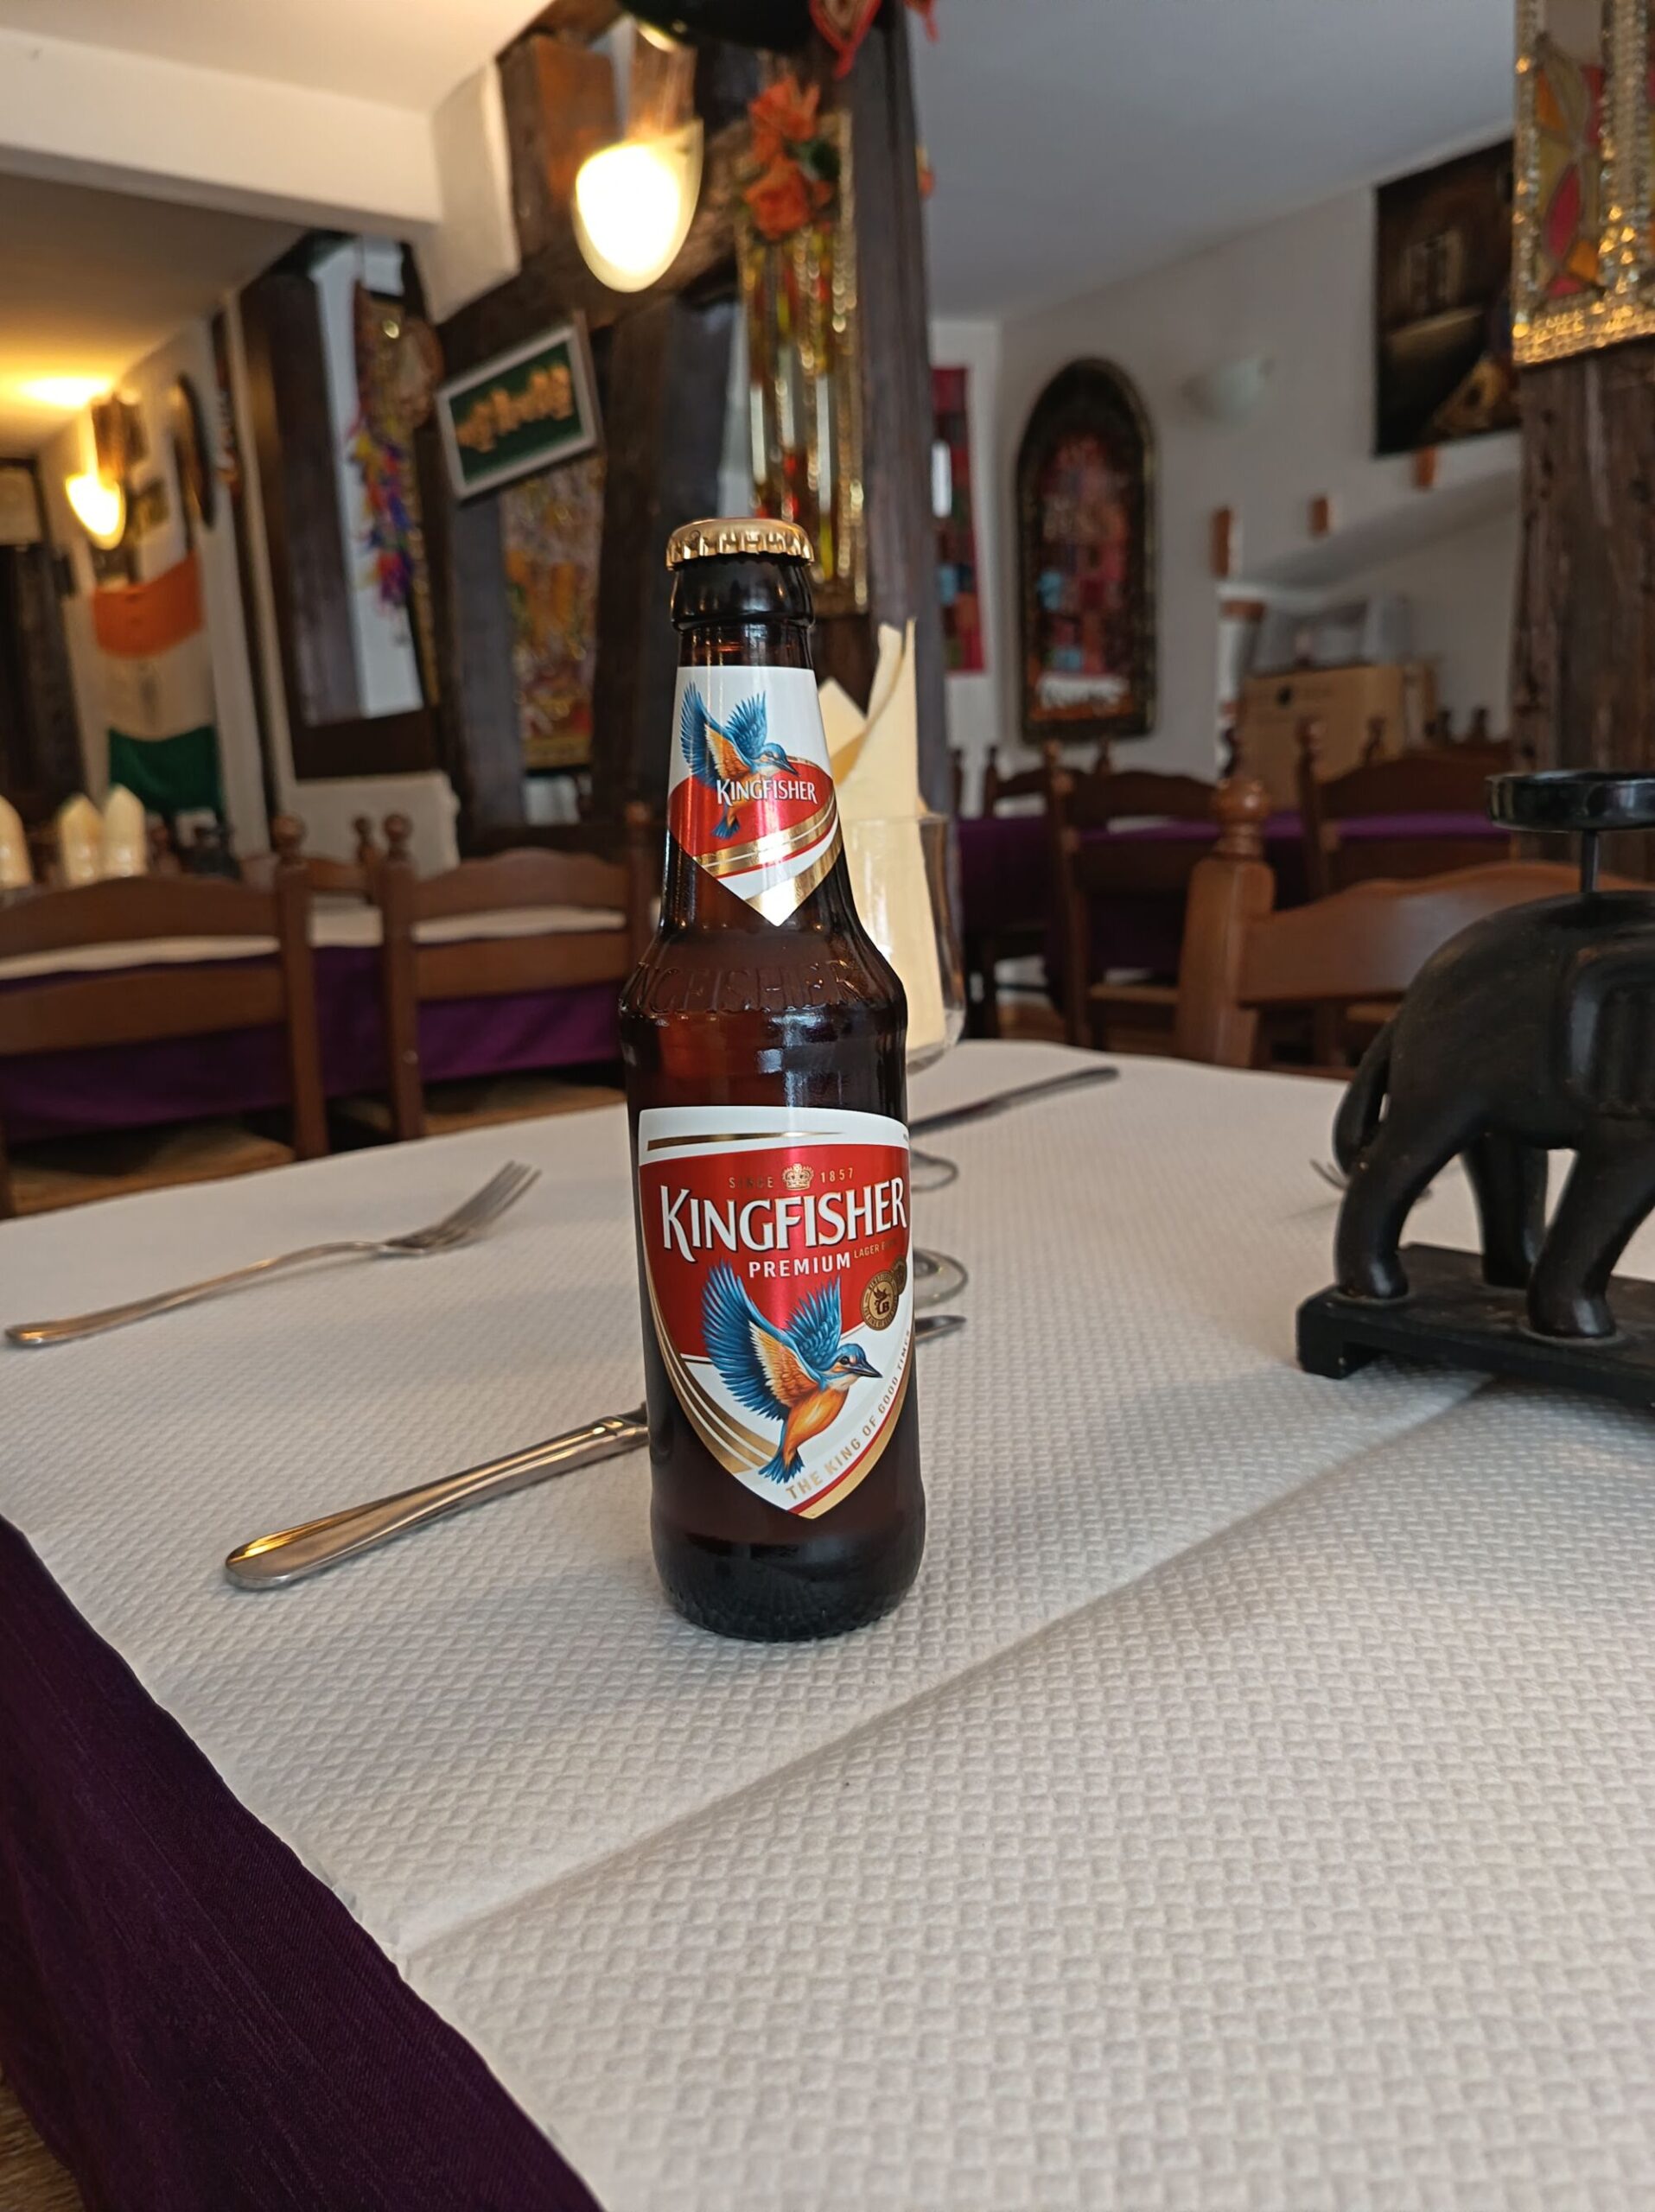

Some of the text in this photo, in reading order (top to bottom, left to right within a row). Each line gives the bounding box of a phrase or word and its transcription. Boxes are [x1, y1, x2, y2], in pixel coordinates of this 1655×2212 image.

[716, 779, 818, 806] KINGFISHER
[820, 1167, 854, 1183] 1857
[659, 1176, 907, 1262] KINGFISHER
[748, 1252, 851, 1278] PREMIUM
[854, 1243, 880, 1259] LAGER
[786, 1471, 824, 1500] THE
[824, 1438, 861, 1476] KING
[862, 1416, 877, 1437] OF
[877, 1376, 899, 1414] GOOD
